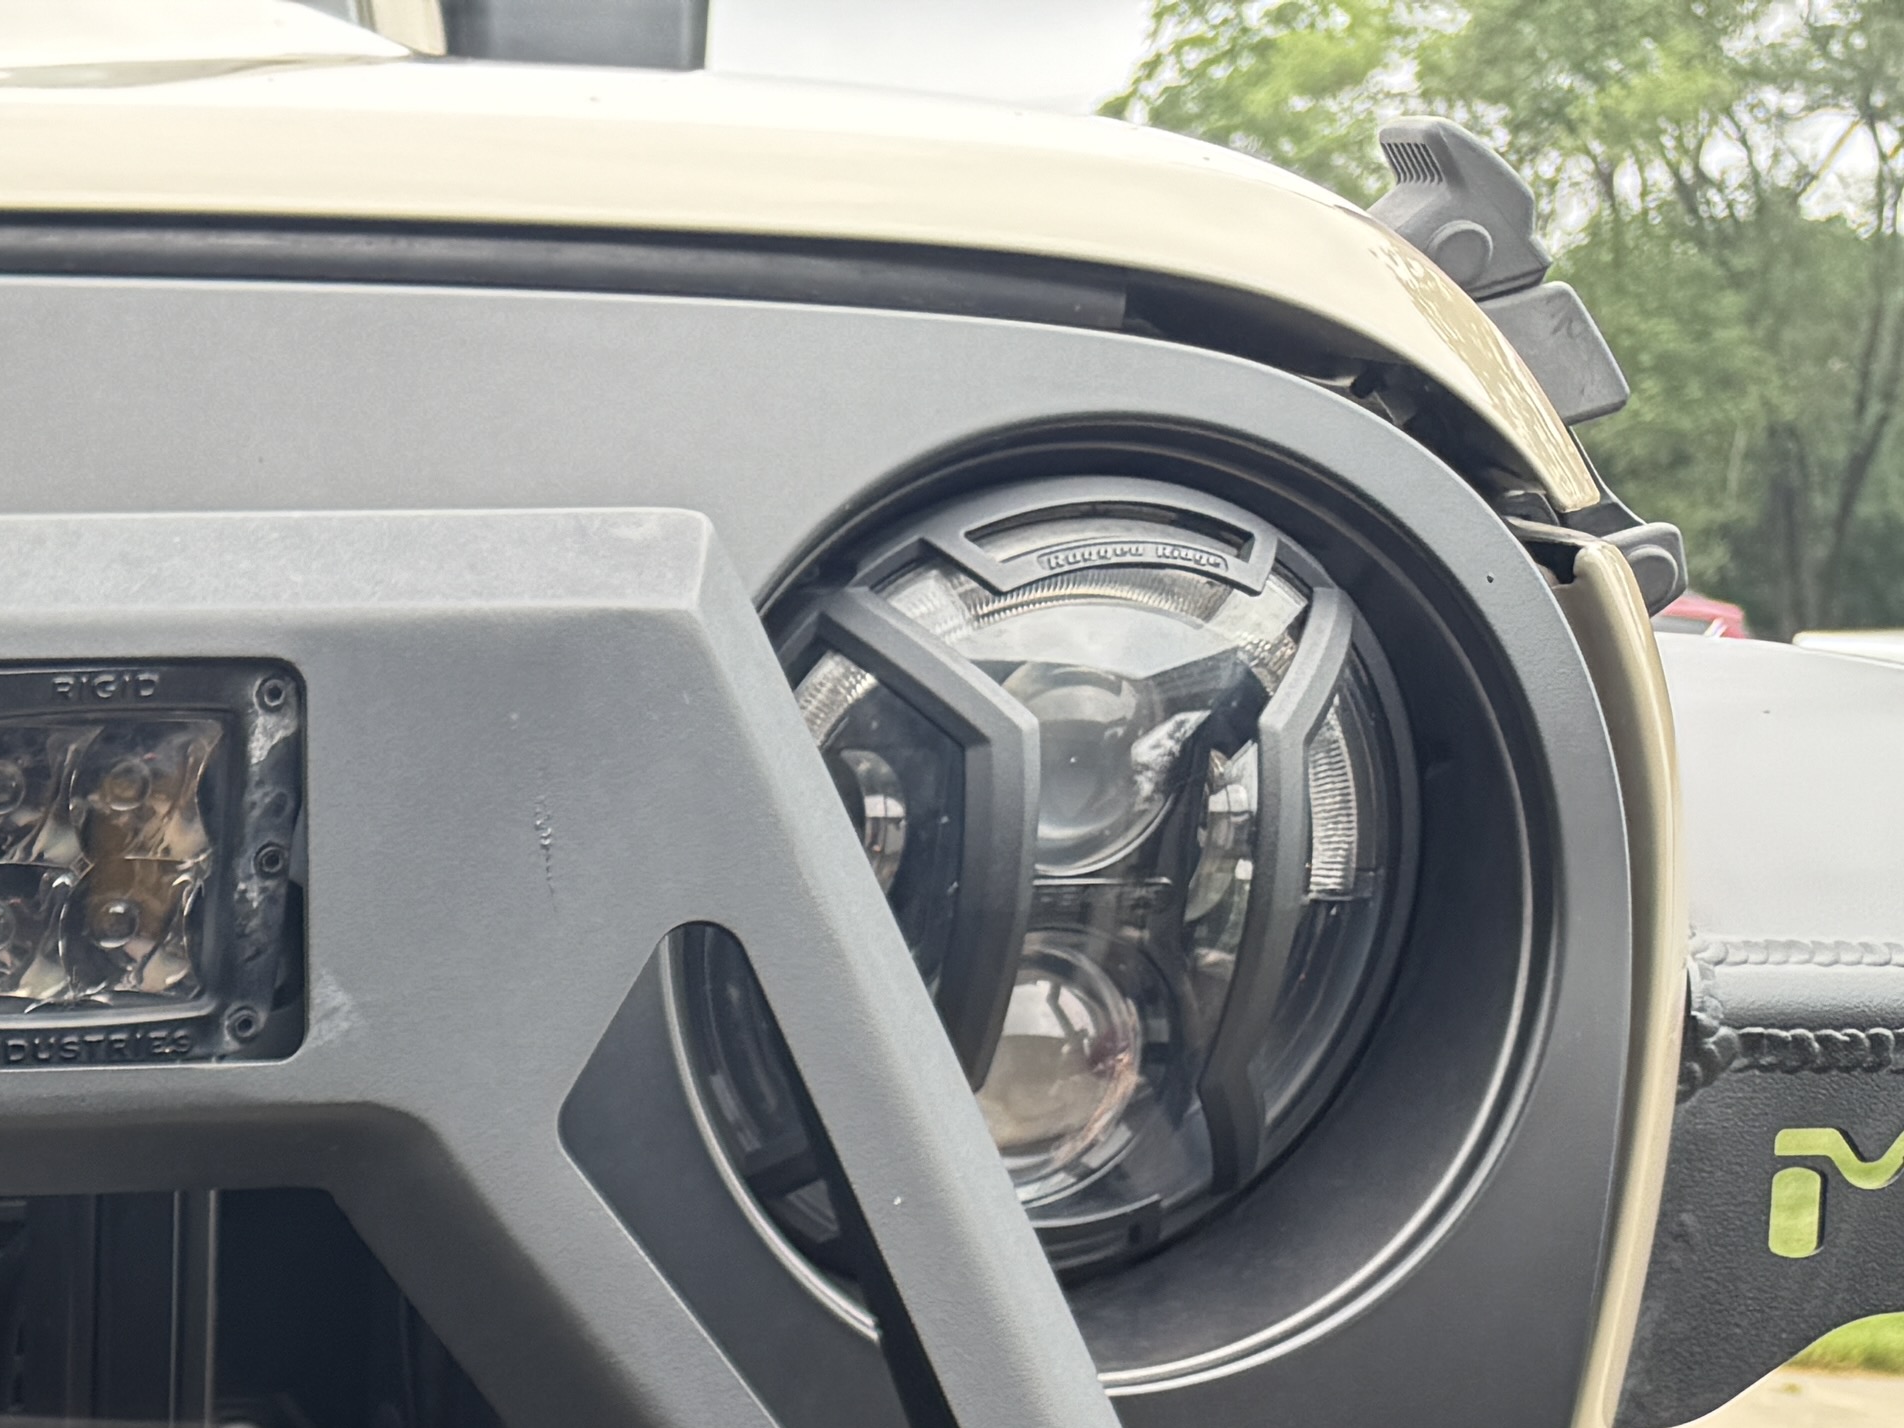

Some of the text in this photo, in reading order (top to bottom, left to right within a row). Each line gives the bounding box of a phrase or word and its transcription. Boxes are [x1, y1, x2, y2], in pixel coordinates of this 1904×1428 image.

[1048, 544, 1222, 570] Rugged Ridge
[52, 673, 160, 700] RIGID
